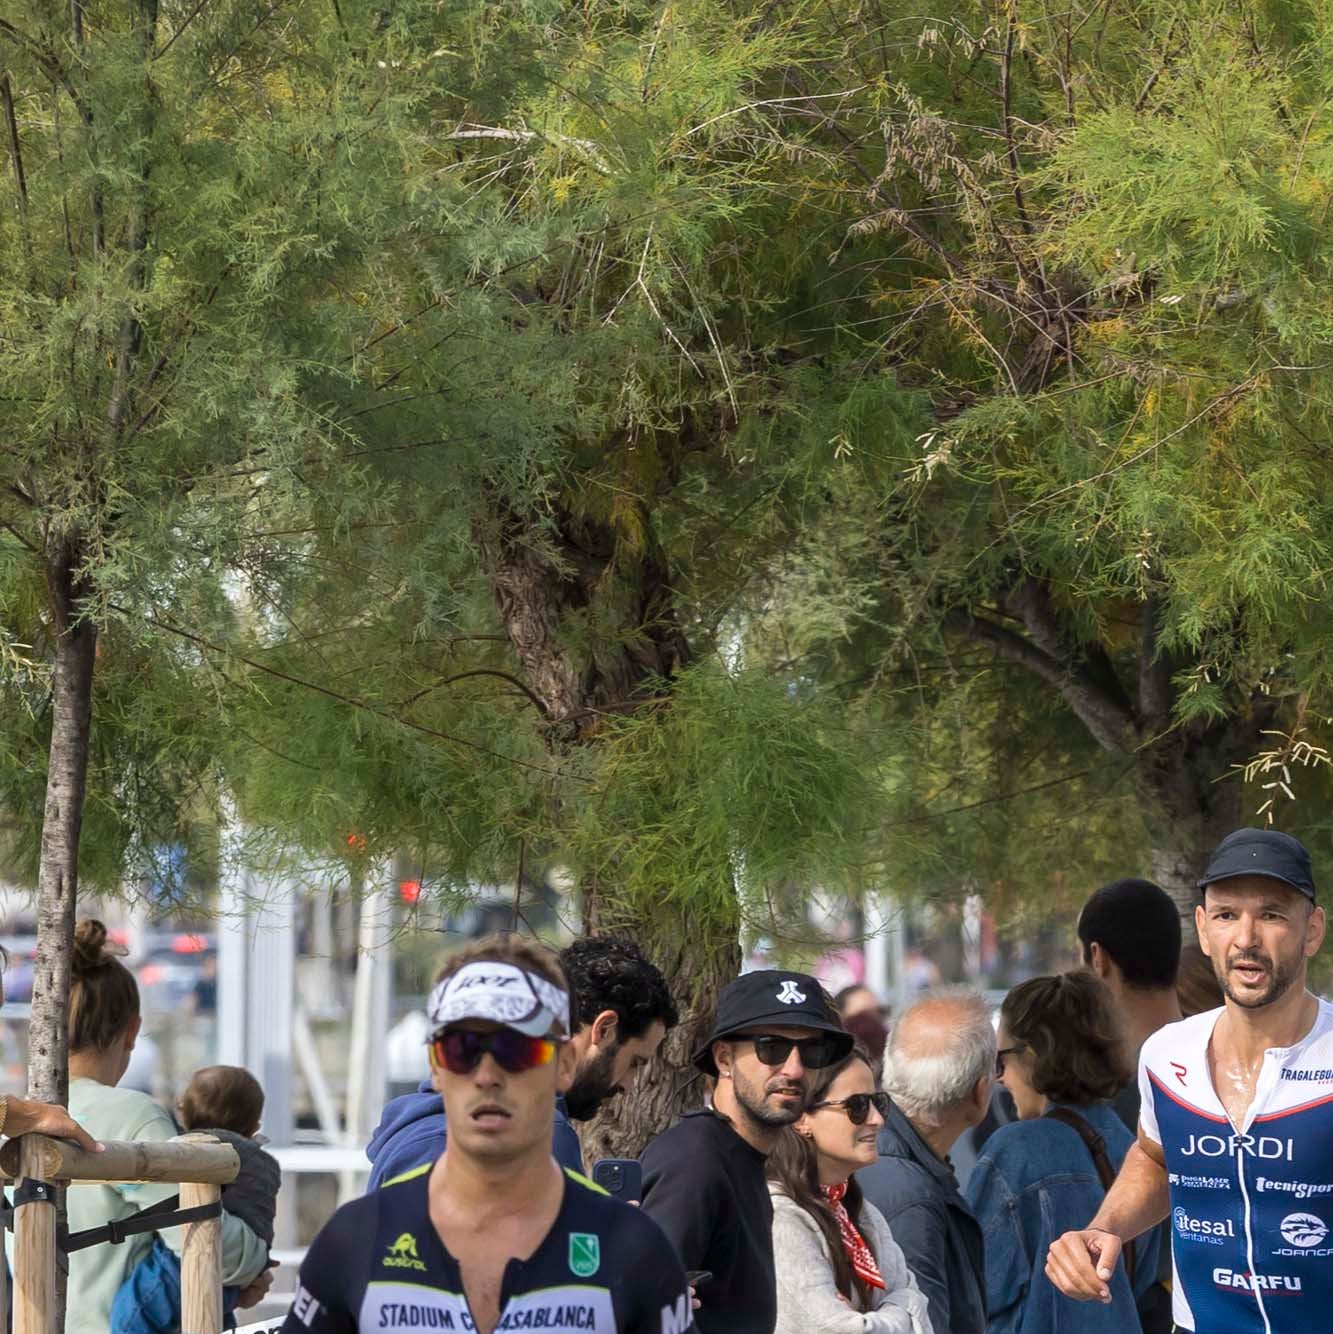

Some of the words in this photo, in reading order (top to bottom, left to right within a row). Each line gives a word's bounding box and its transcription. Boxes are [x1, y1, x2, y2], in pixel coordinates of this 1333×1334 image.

[1181, 1134, 1293, 1160] JORDI
[1180, 1232, 1224, 1246] ventanas
[1213, 1268, 1301, 1290] GARFU
[379, 1304, 455, 1330] STADIUM
